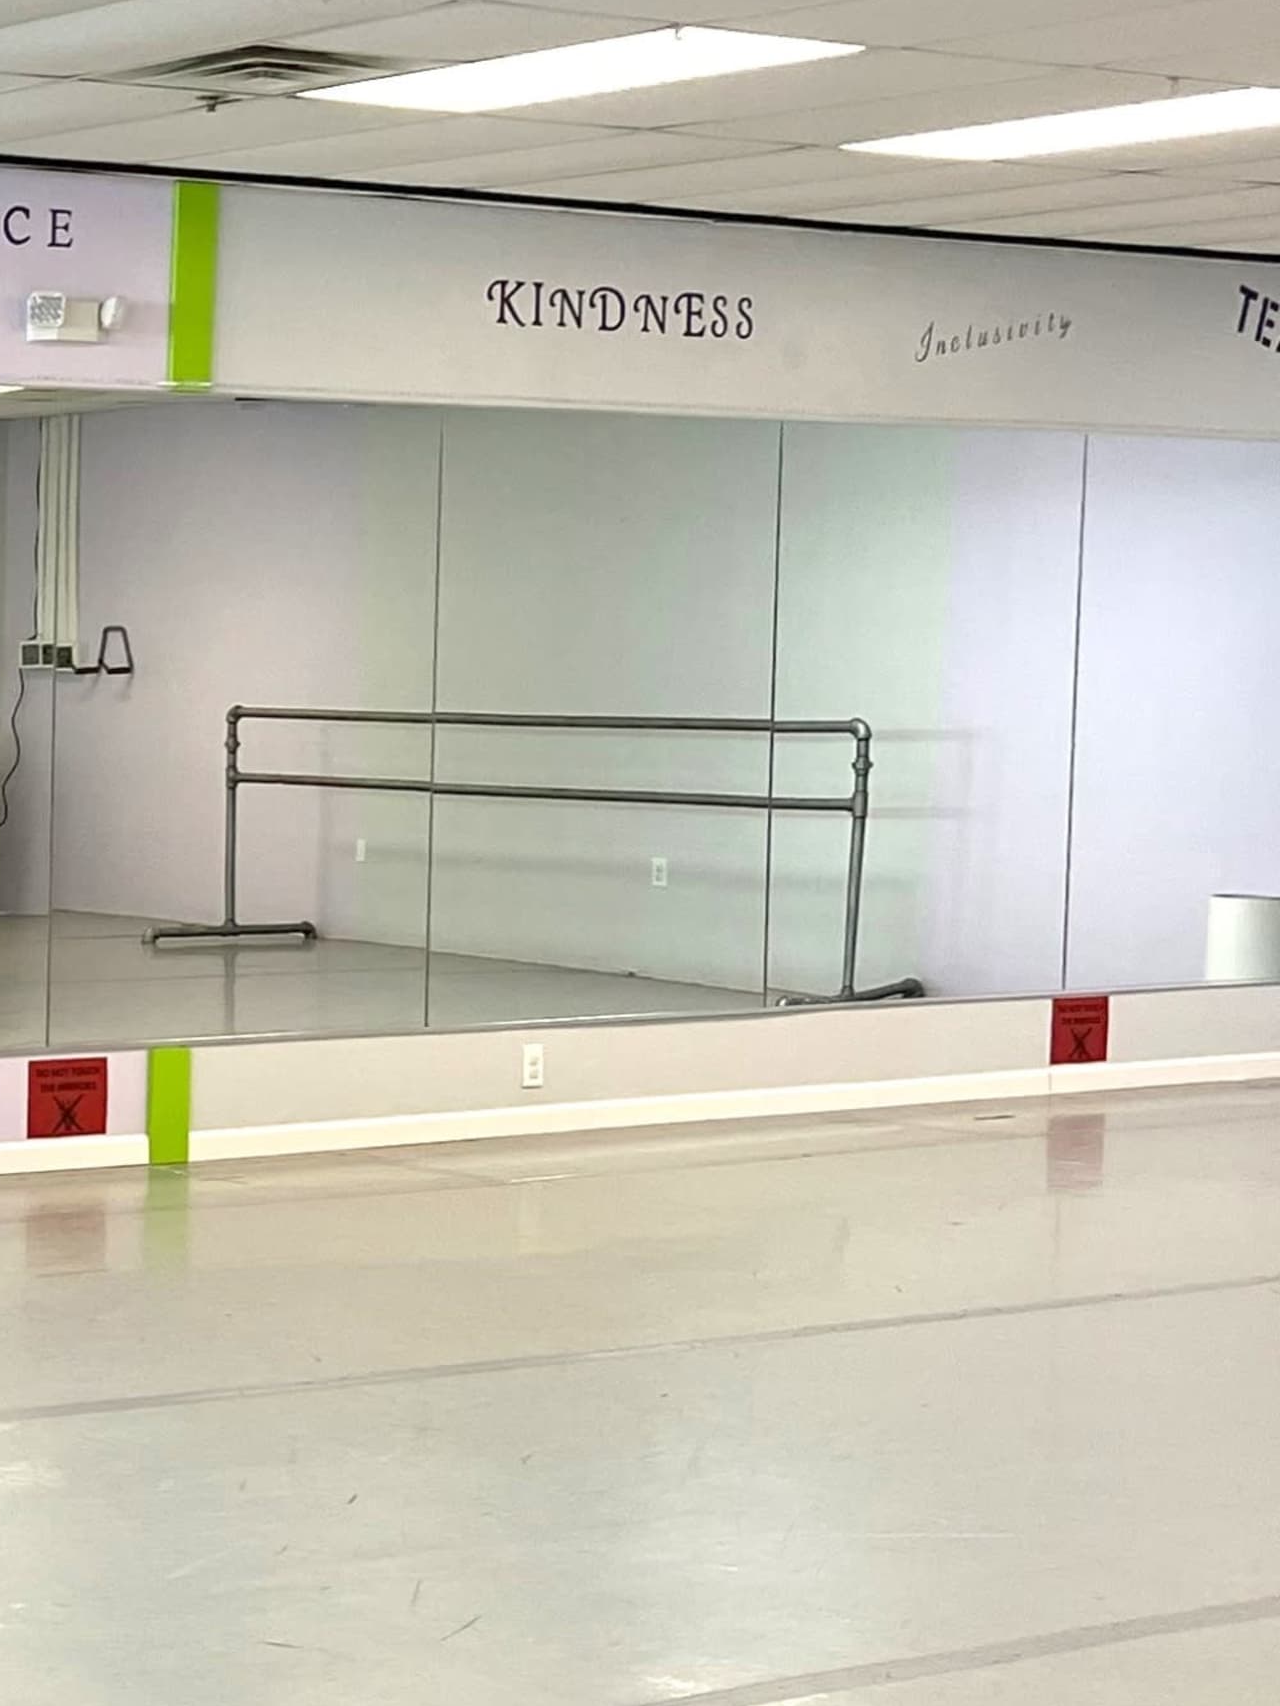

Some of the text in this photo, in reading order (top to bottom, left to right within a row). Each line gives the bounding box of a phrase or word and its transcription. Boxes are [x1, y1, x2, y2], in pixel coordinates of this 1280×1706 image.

[486, 279, 756, 339] KINDNESS
[914, 311, 1073, 364] Inclusivity
[1237, 284, 1280, 353] TE
